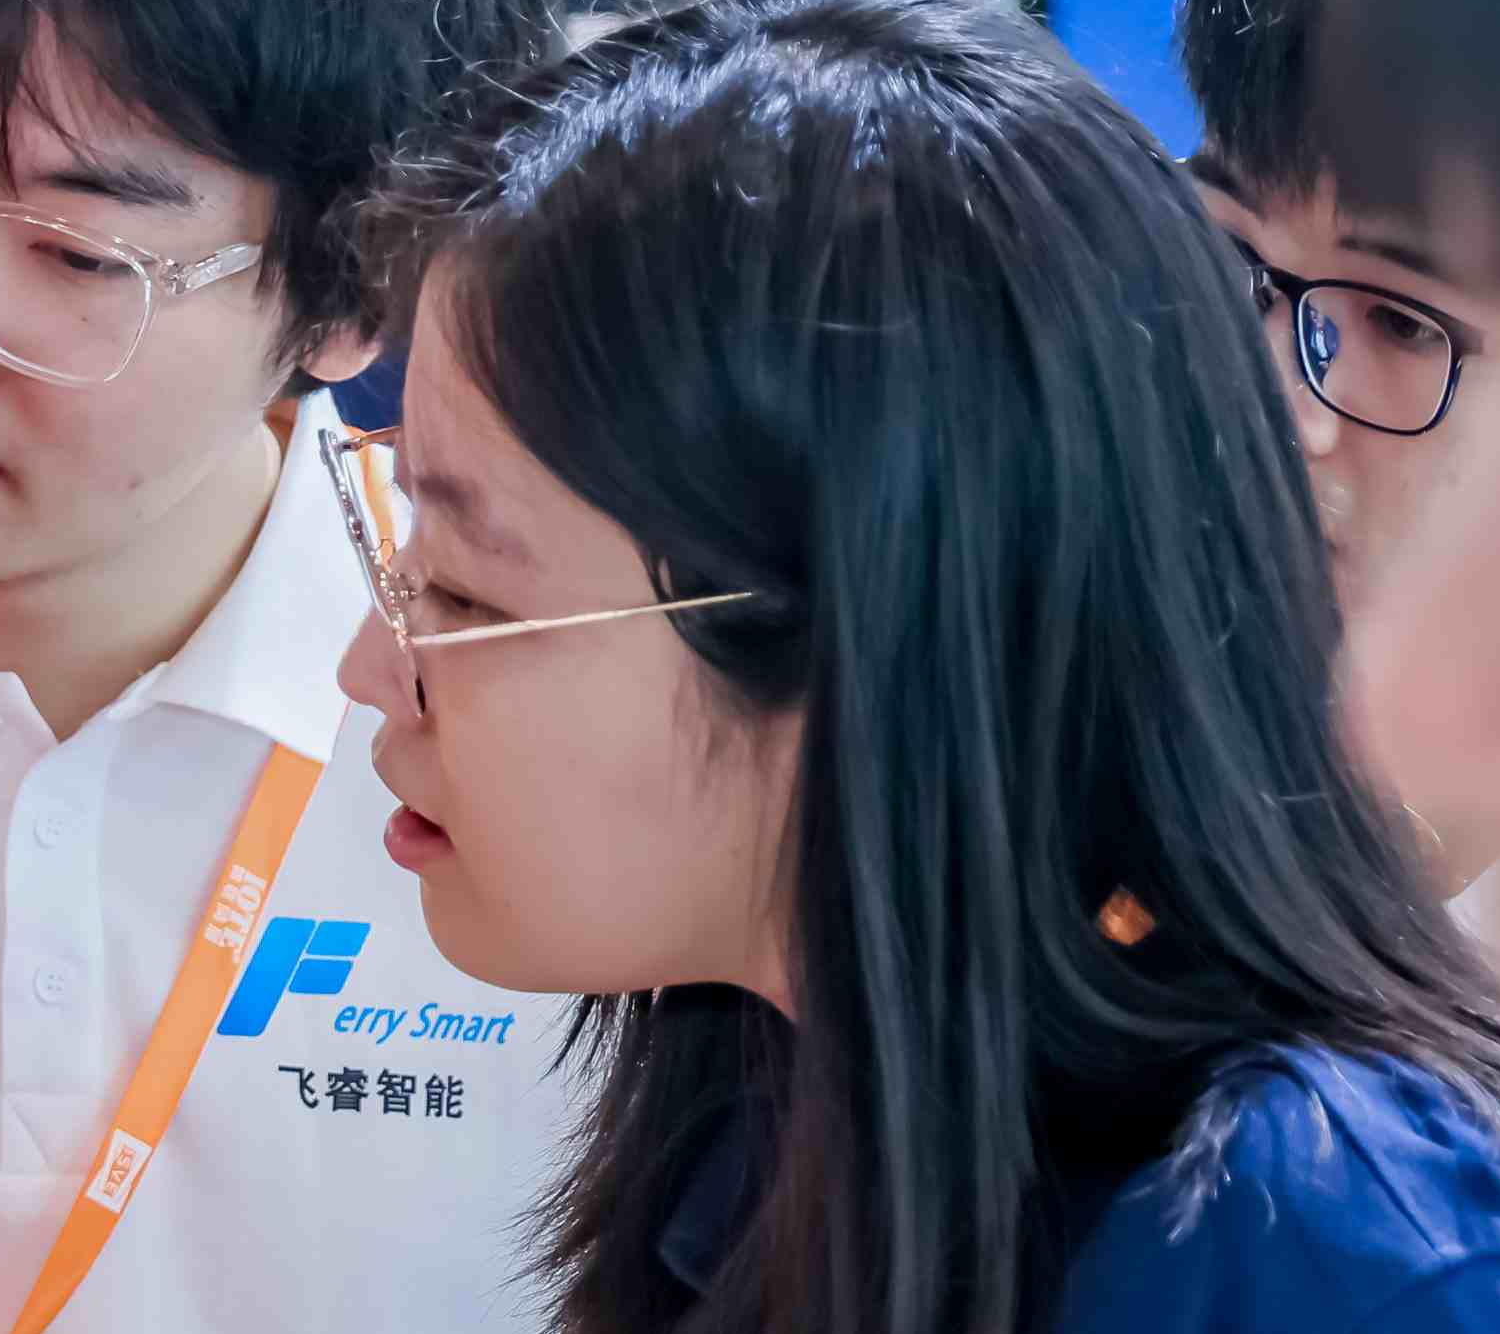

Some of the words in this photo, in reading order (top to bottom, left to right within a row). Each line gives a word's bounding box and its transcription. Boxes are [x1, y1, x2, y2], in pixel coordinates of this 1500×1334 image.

[410, 1002, 515, 1044] Smart
[278, 1065, 464, 1118] 飞睿智能
